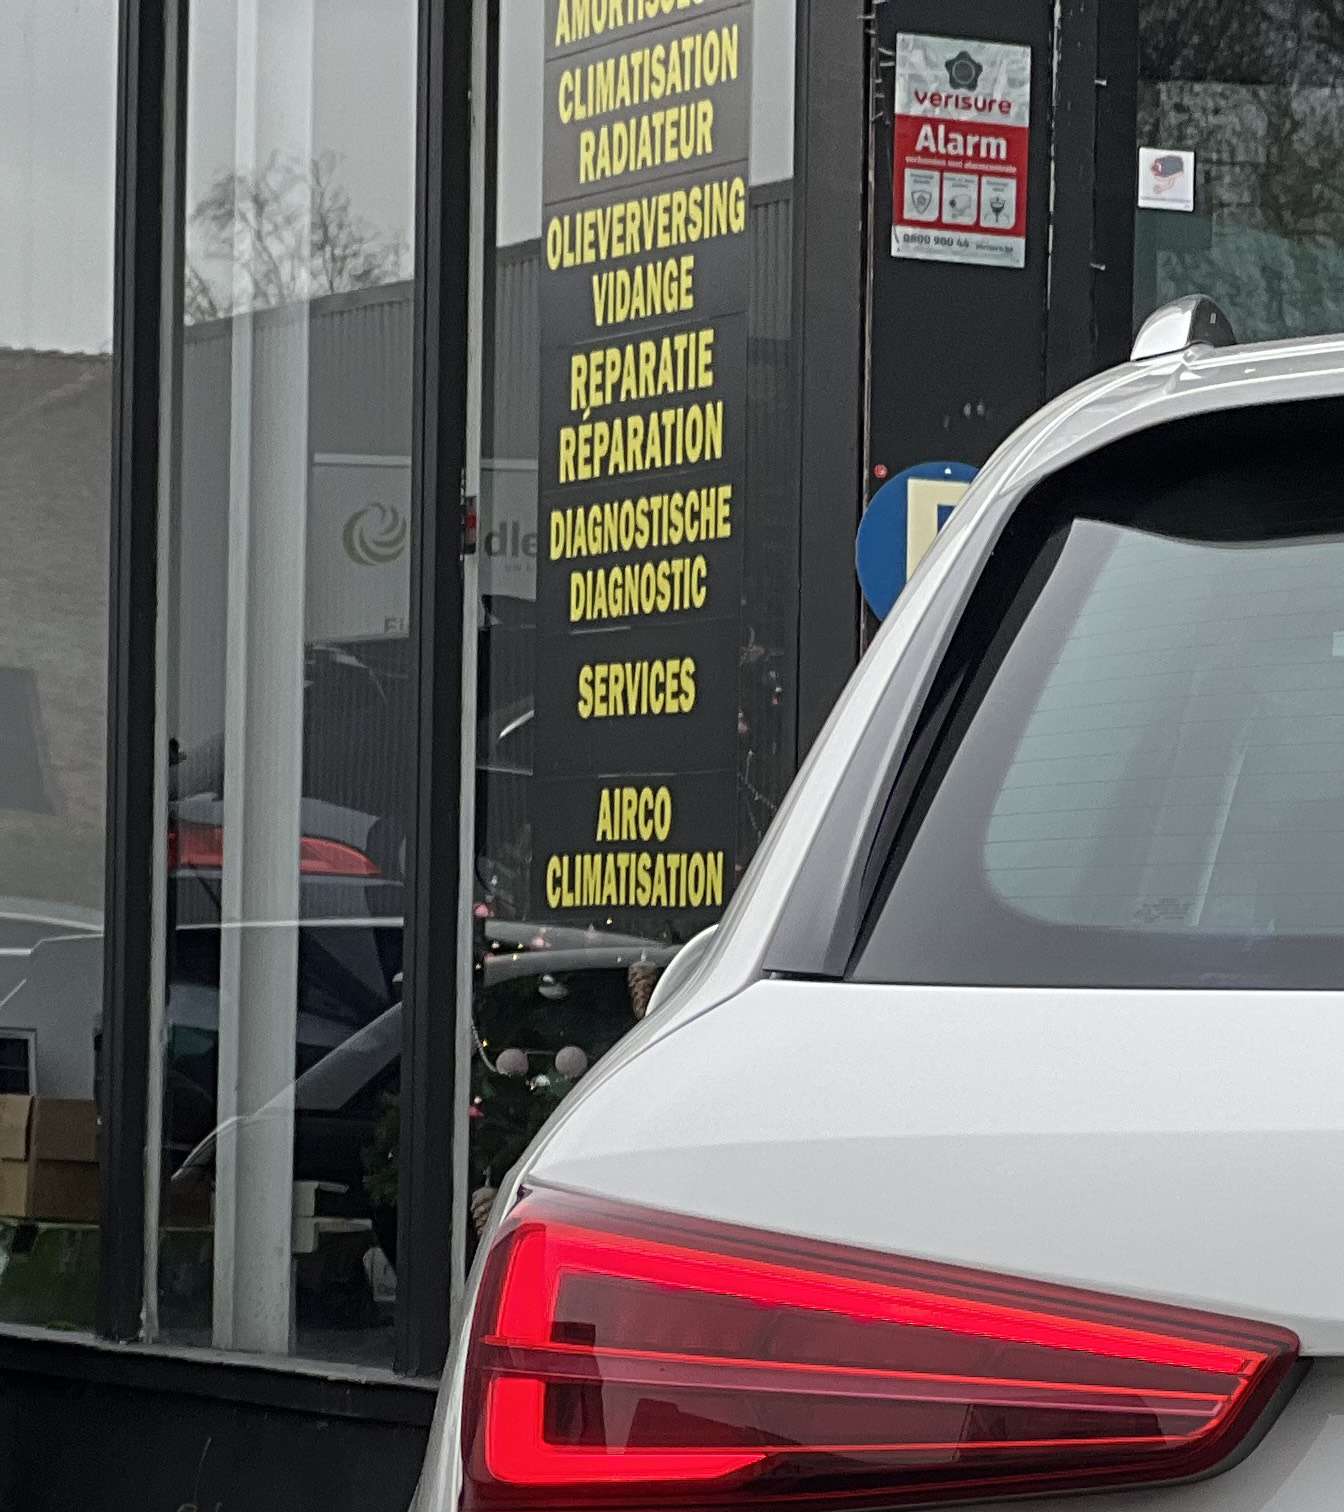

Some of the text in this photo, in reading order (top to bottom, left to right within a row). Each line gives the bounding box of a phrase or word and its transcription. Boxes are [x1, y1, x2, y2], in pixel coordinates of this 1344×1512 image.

[558, 24, 738, 124] CLIMATISATION
[914, 87, 1012, 115] verisure
[579, 99, 713, 184] RADIATEUR
[915, 123, 1007, 160] Alarm
[547, 176, 745, 271] OLIEVERVERSING
[592, 255, 694, 327] VIDANGE
[570, 328, 714, 411] REPARATIE
[559, 400, 723, 484] RÉPARATION
[550, 484, 732, 561] DIAGNOSTISCHE
[570, 554, 707, 622] DIAGNOSTIC
[578, 657, 696, 719] SERVICES
[596, 786, 672, 841] AIRCO
[546, 851, 724, 908] CLIMATISATION
